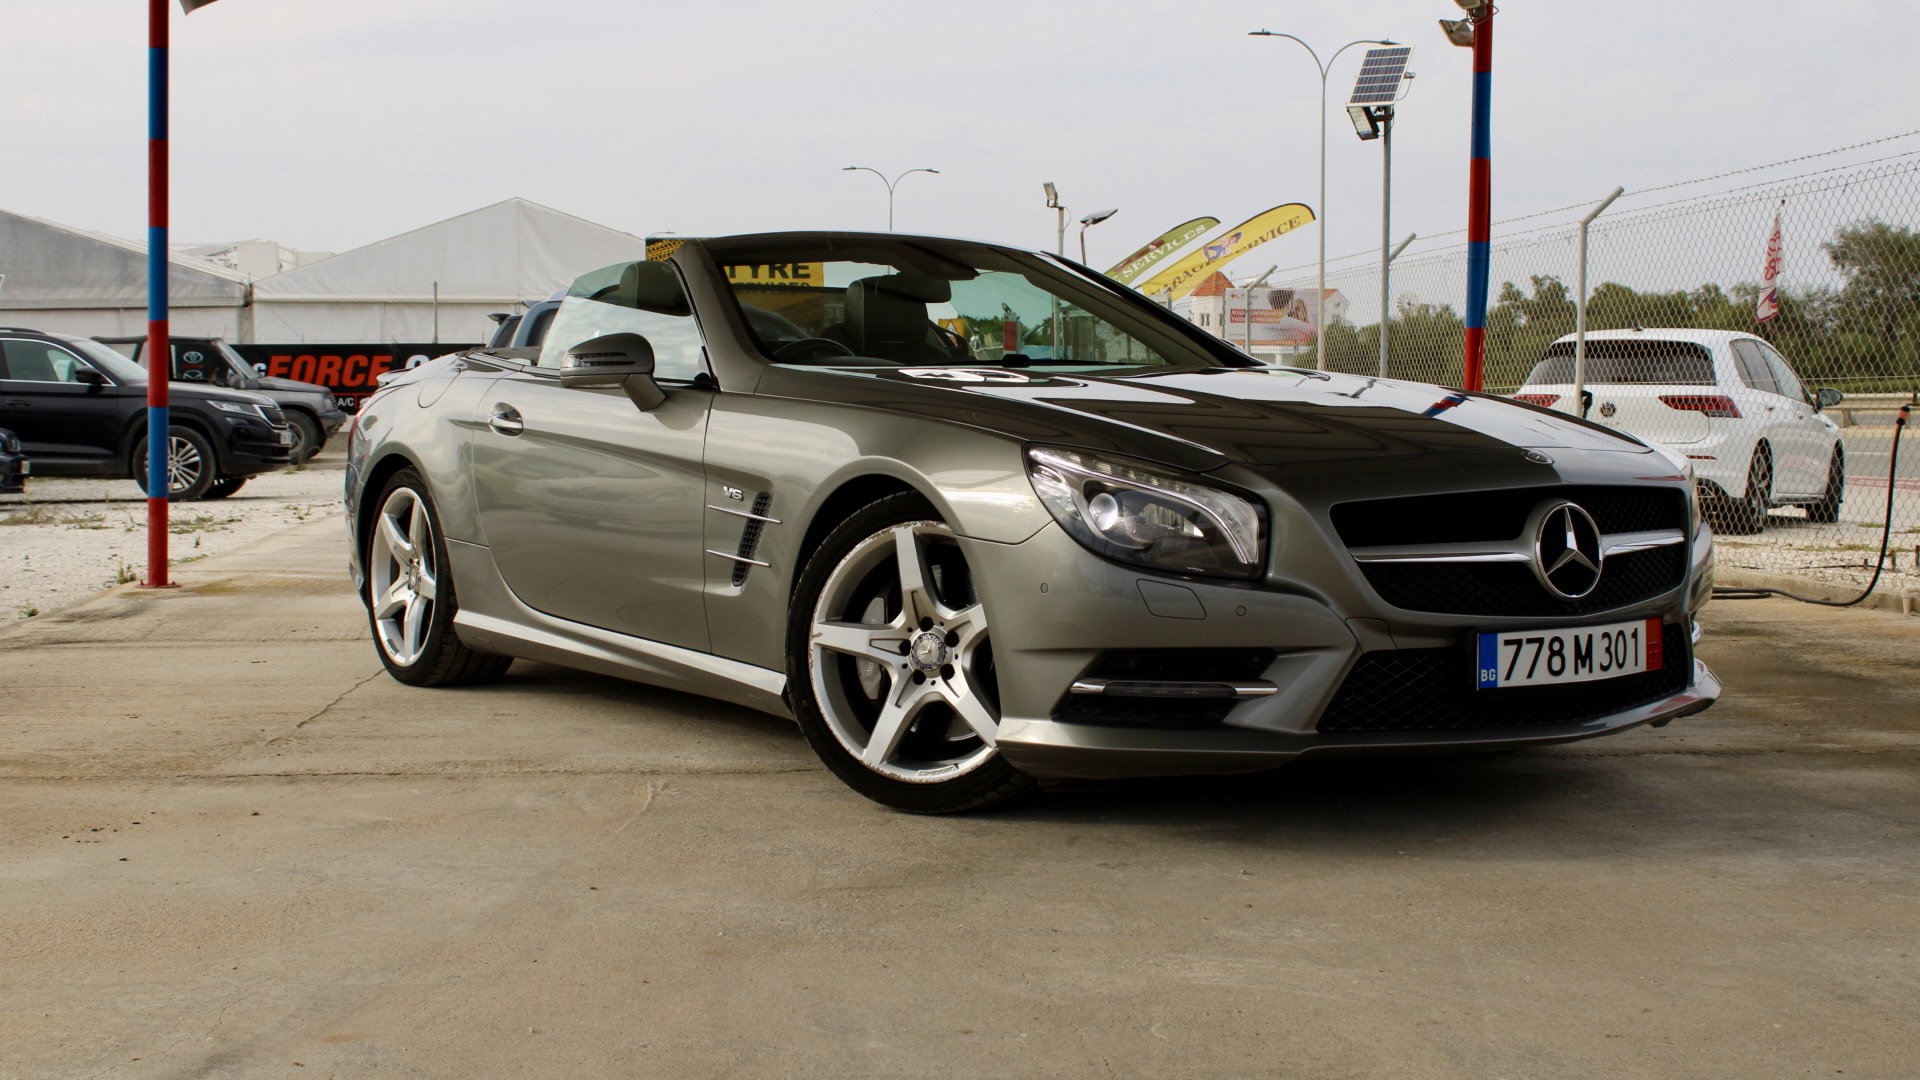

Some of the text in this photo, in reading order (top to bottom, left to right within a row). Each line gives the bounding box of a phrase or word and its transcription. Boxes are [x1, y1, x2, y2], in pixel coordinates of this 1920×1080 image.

[1122, 224, 1206, 279] SERVICES
[266, 354, 393, 387] FORCE
[337, 397, 355, 407] A/C
[1480, 668, 1497, 682] BG
